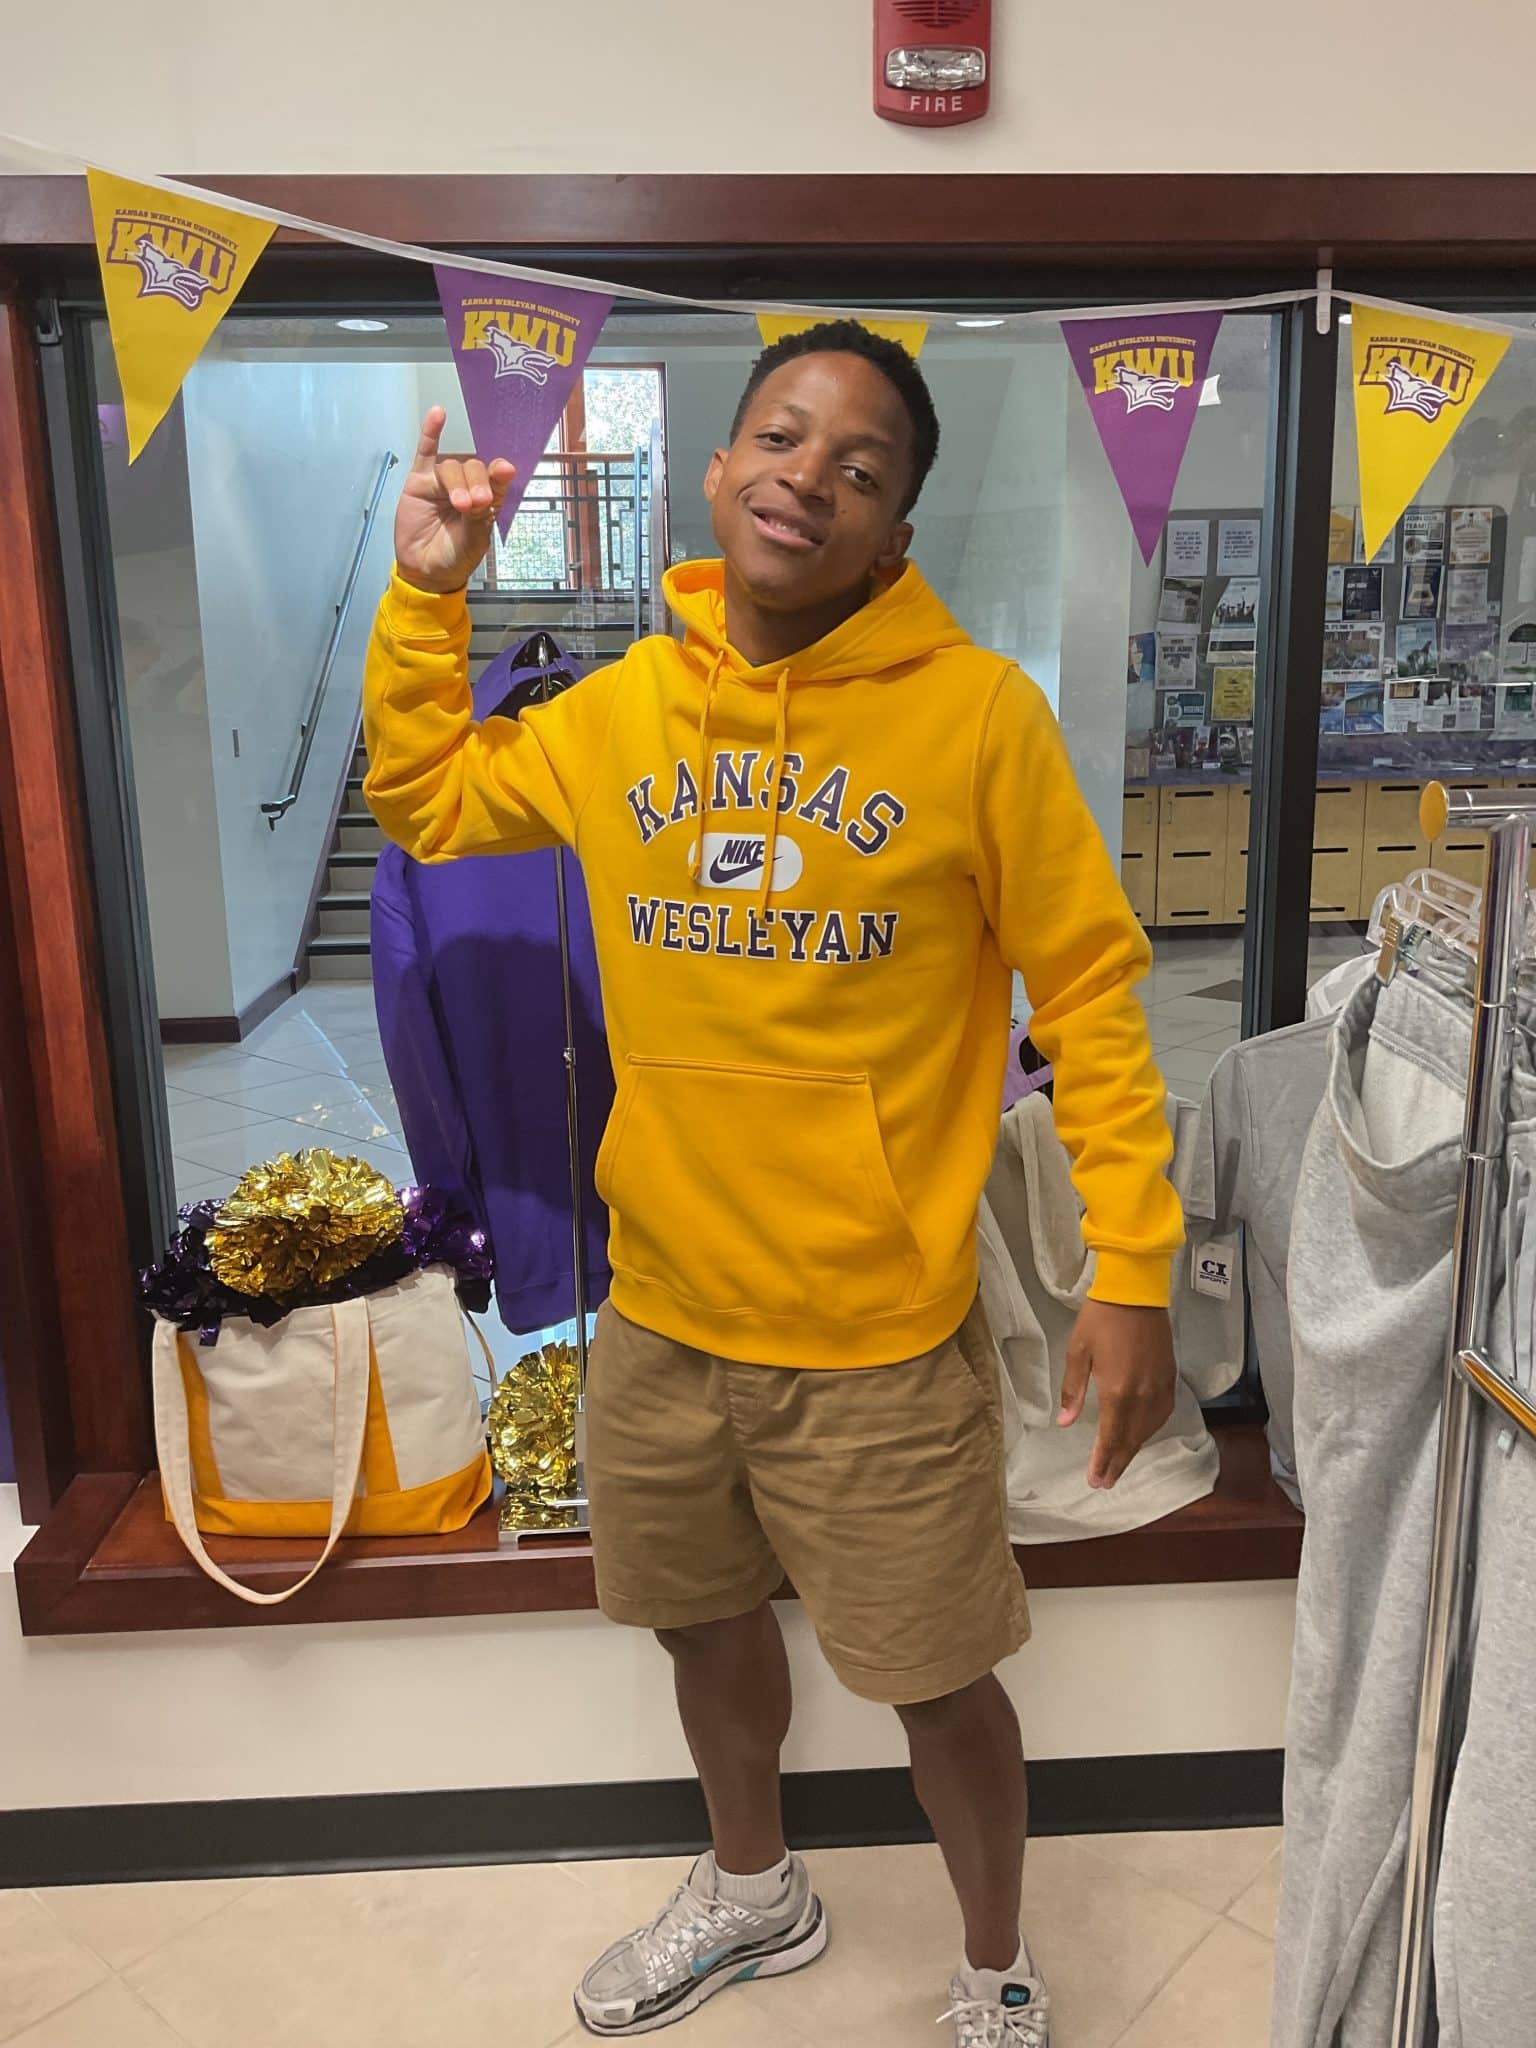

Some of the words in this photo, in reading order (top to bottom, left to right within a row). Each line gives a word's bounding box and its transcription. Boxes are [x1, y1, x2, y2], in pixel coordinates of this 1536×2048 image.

[910, 96, 963, 112] FIRE
[115, 209, 148, 218] KANSAS
[150, 212, 193, 228] WESLEYAN
[194, 223, 239, 250] UNIVERSITY
[107, 219, 236, 293] KWU
[461, 298, 493, 306] KANSAS
[494, 299, 536, 311] WESLEYAN
[537, 305, 581, 326] UNIVERSITY
[462, 311, 576, 367] KWU
[1089, 341, 1117, 354] KANSAS
[1118, 336, 1155, 345] WESLEYAN
[1156, 336, 1197, 347] UNIVERSITY
[1399, 337, 1436, 349] WESLEYAN
[1093, 348, 1195, 394] KWU
[1359, 345, 1474, 405] KWU
[626, 750, 906, 857] KANSAS
[719, 839, 765, 865] NIKE
[627, 893, 899, 964] WESLEYAN
[1201, 1260, 1227, 1277] CI
